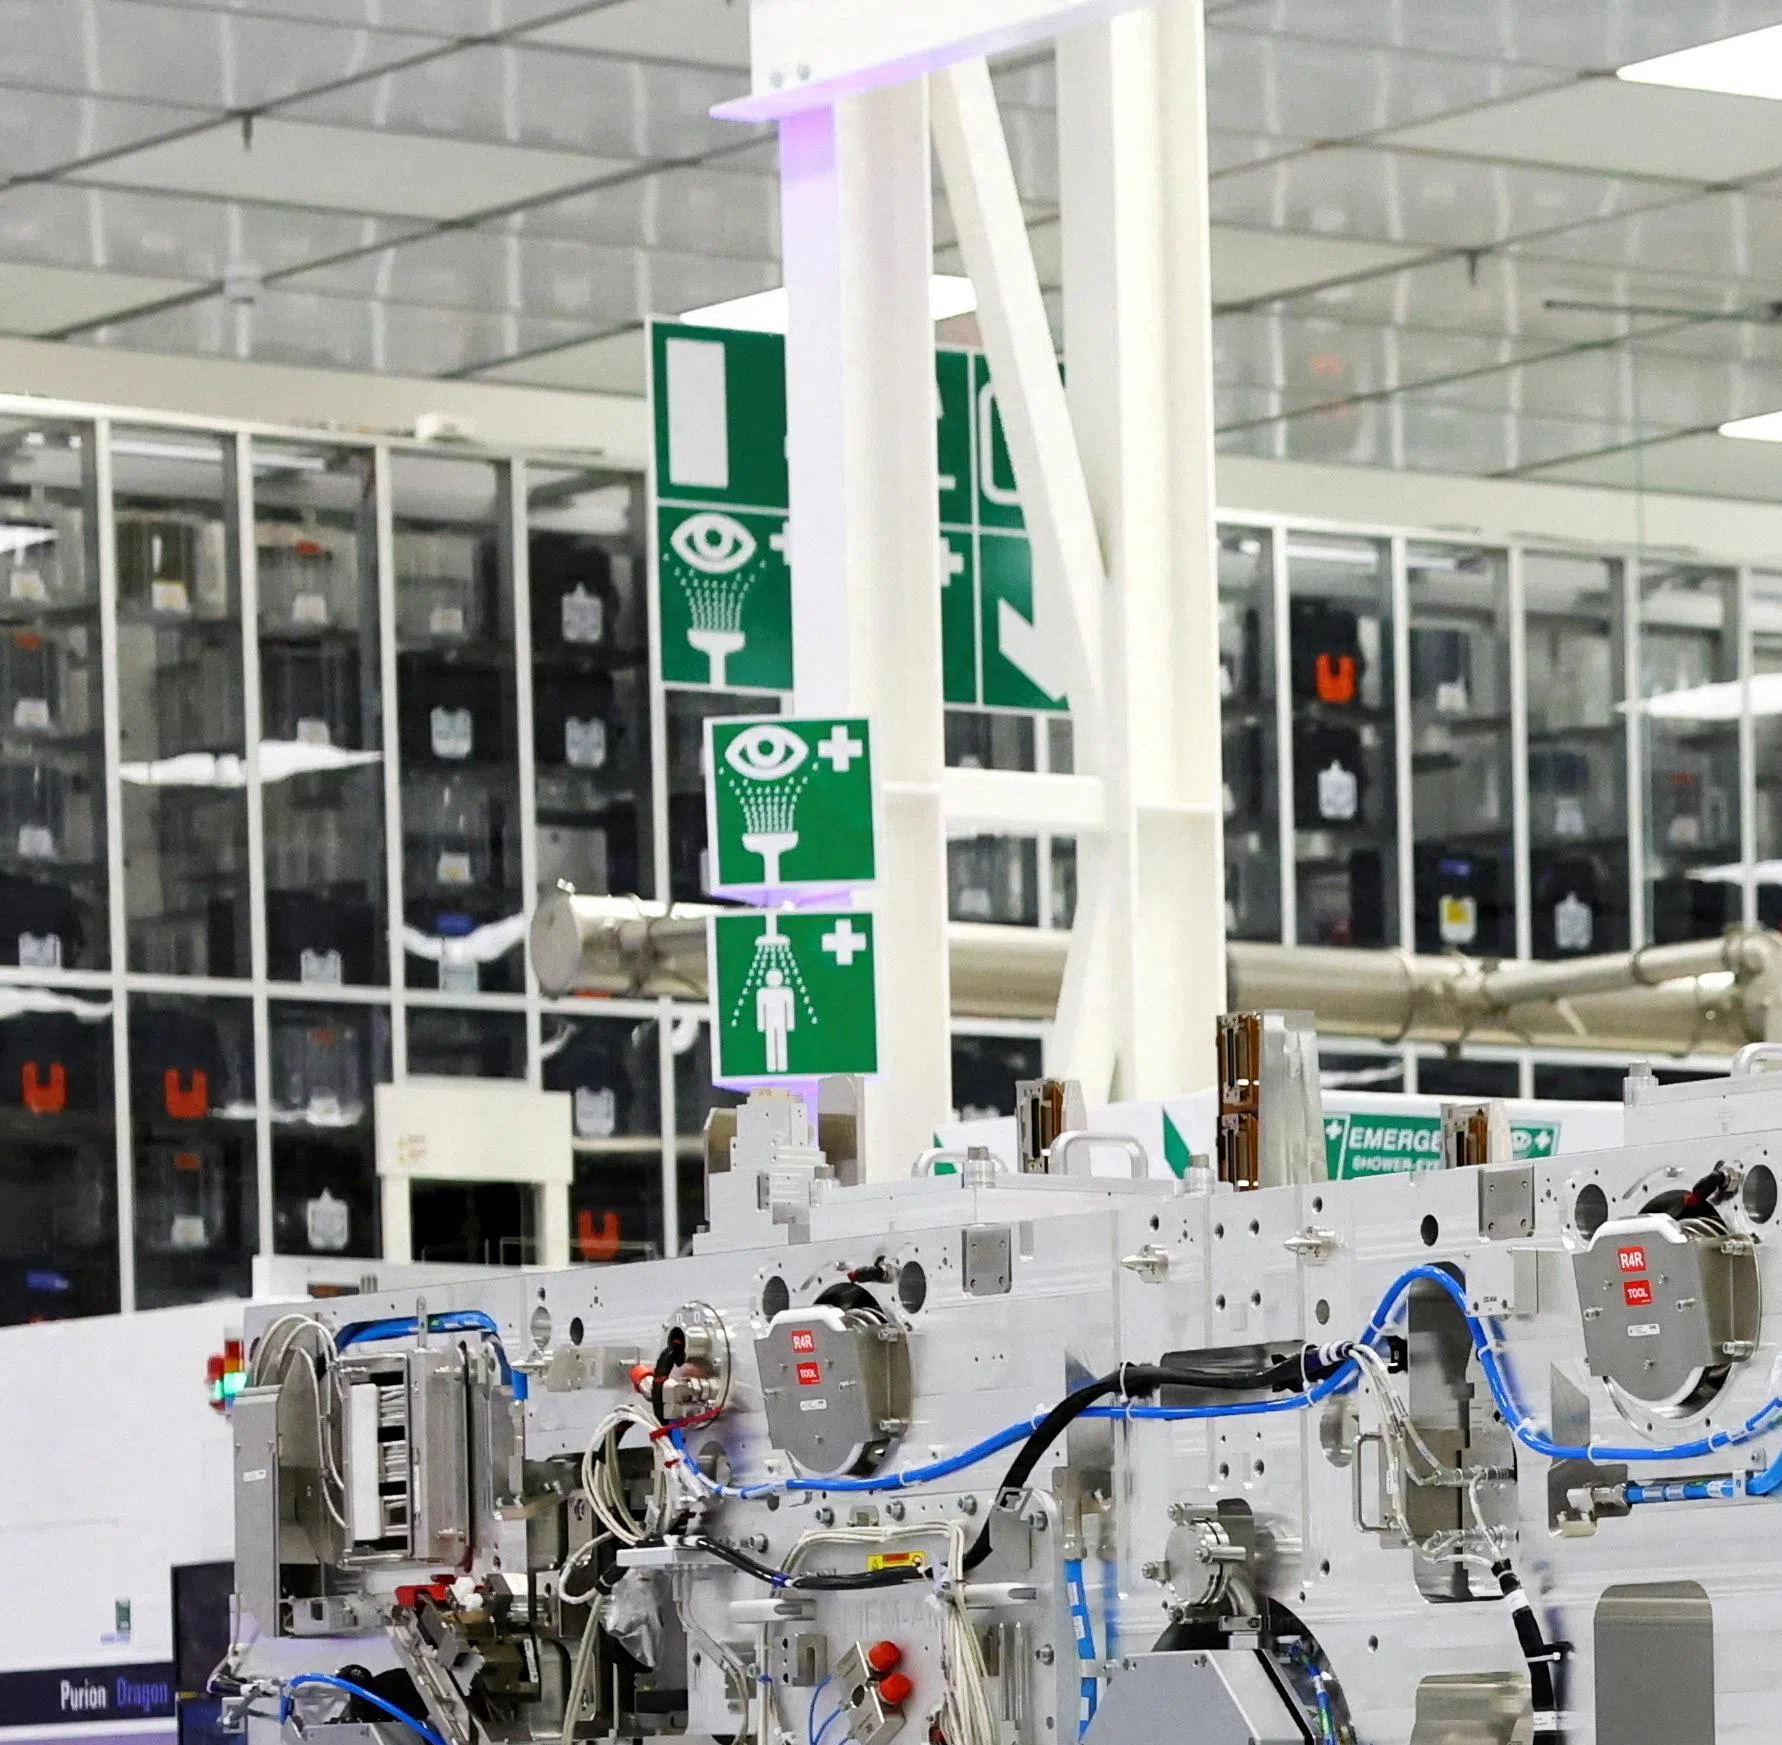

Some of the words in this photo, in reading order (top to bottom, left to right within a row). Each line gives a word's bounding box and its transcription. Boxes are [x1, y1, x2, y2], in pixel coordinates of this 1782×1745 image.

[1620, 1253, 1645, 1268] R4R
[1628, 1290, 1648, 1299] TOOL
[60, 1678, 107, 1711] Purion
[117, 1676, 169, 1712] Dragon
